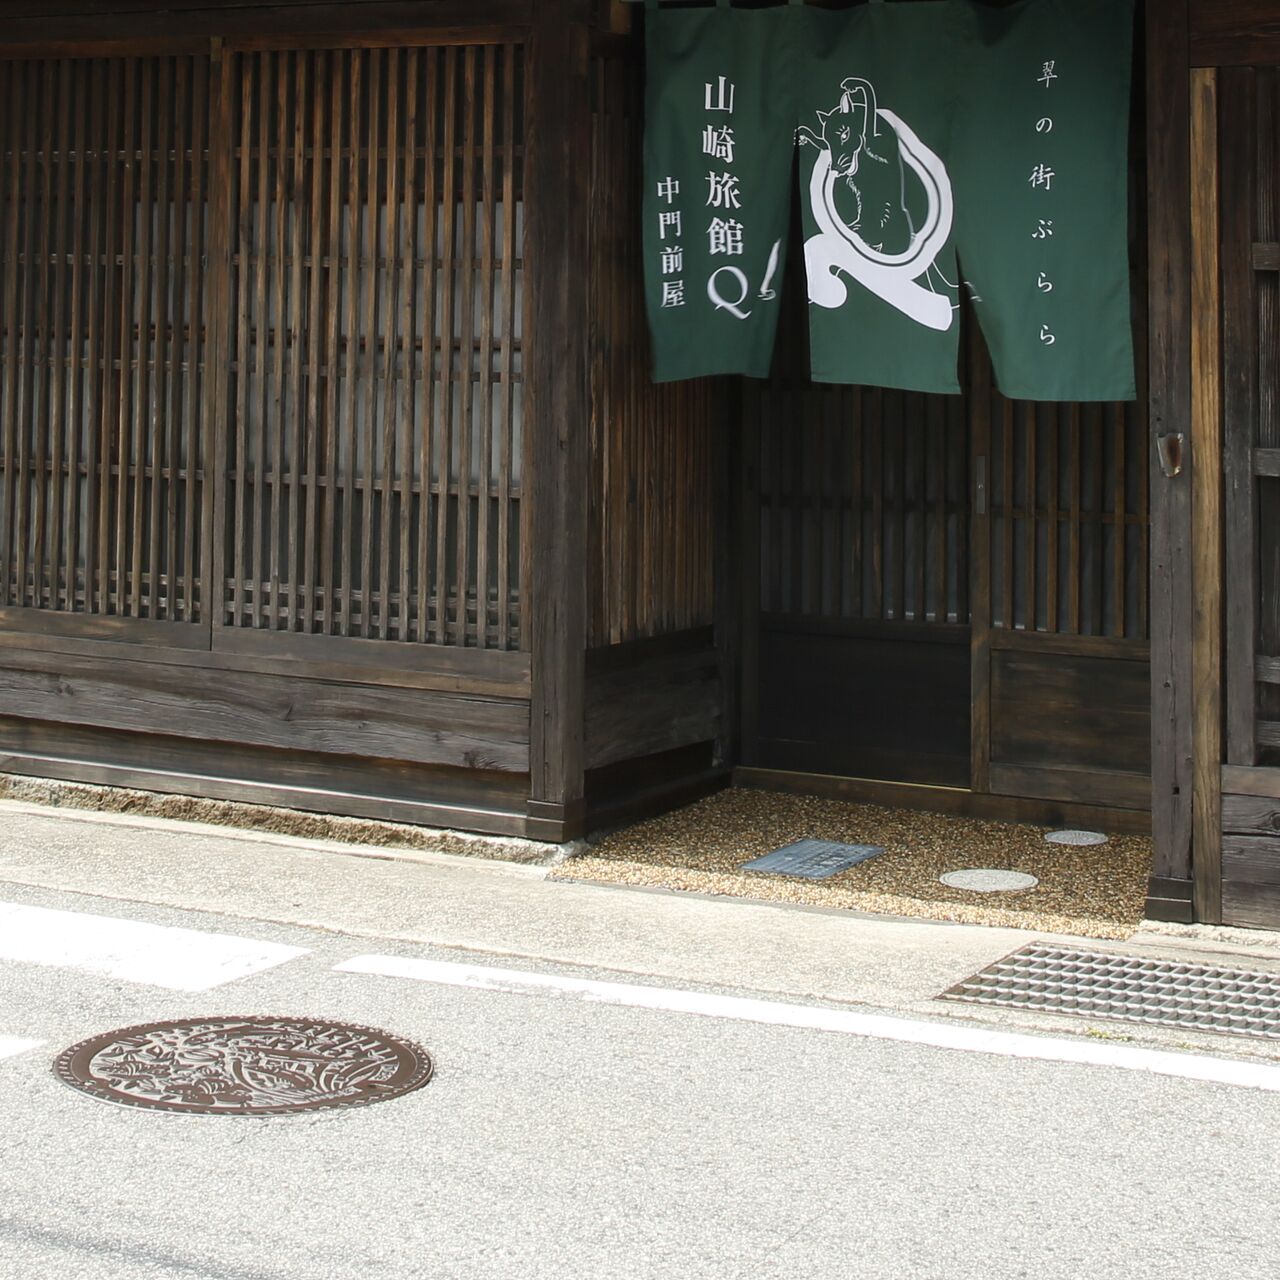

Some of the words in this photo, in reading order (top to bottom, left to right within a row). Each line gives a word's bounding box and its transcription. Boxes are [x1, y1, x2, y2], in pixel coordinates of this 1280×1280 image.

[657, 176, 686, 308] 中門前屋
[702, 75, 752, 320] 山崎旅館Q
[1027, 60, 1057, 345] 翠の街ぶらら
